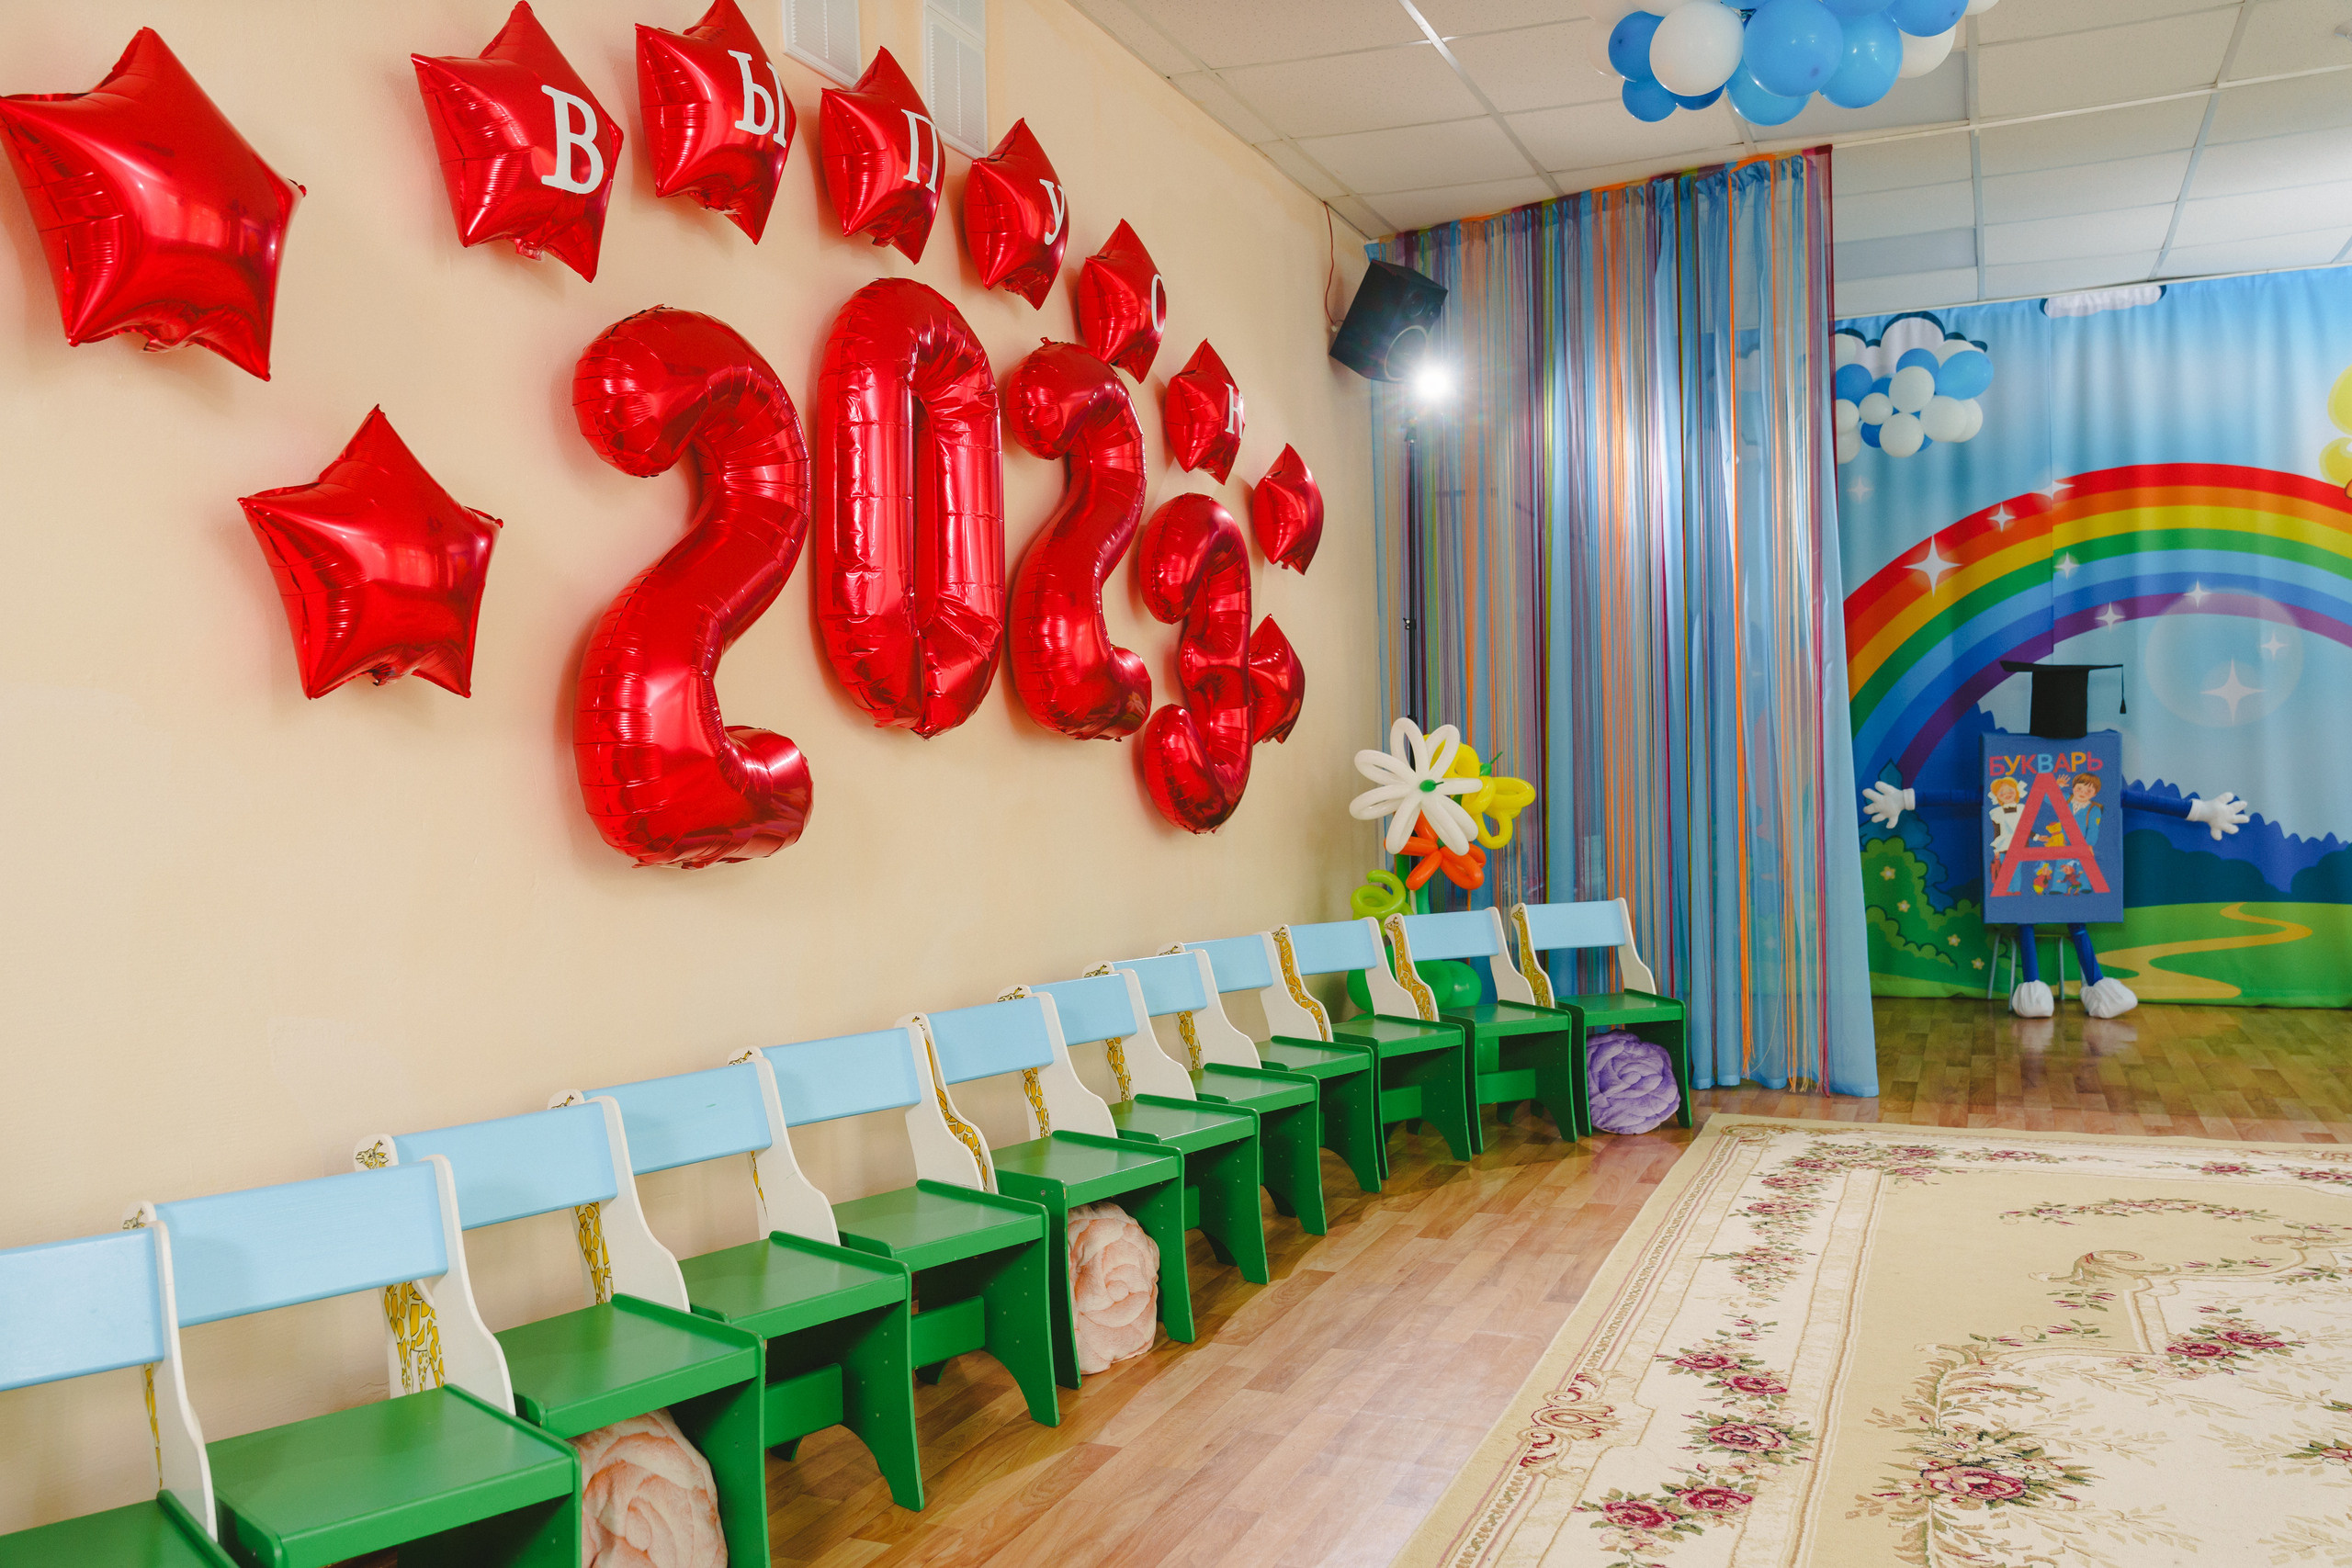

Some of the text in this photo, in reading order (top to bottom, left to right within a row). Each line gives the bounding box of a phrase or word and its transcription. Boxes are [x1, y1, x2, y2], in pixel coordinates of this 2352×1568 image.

[571, 277, 1252, 870] 2023
[1988, 750, 2104, 777] БУКВАРЬ
[1989, 772, 2111, 897] А
